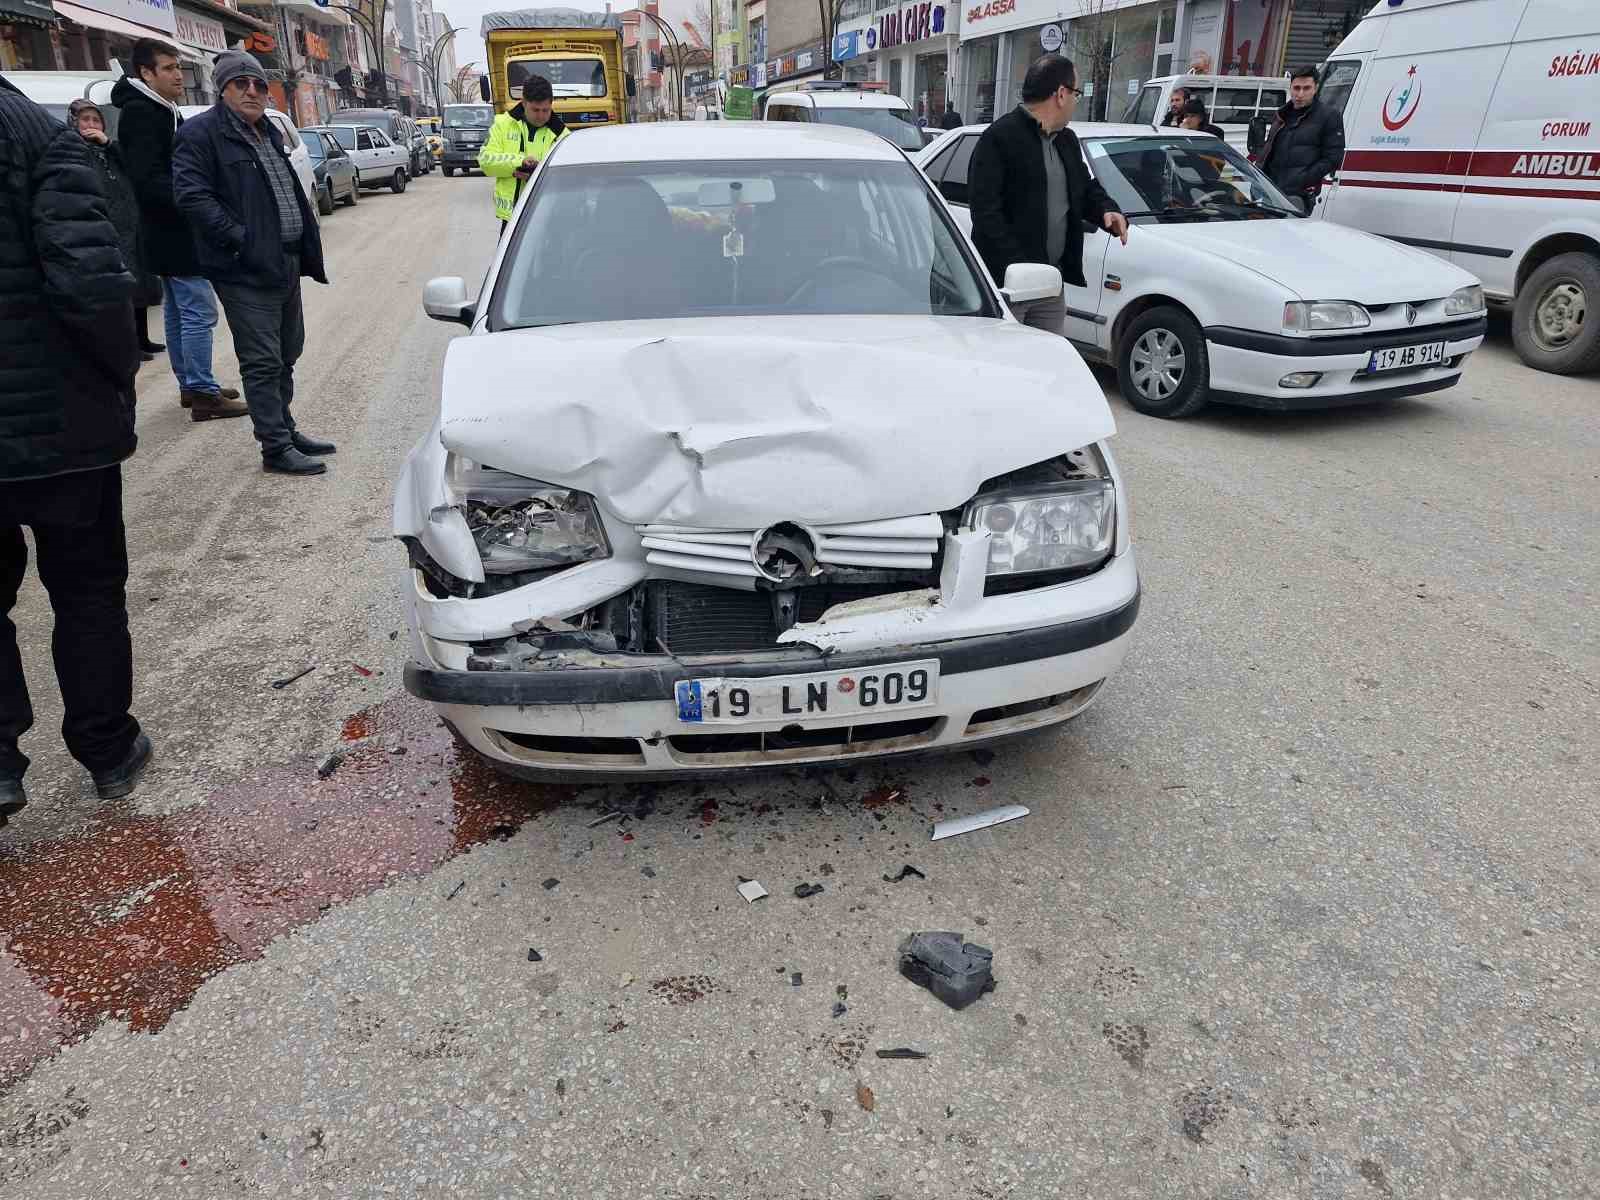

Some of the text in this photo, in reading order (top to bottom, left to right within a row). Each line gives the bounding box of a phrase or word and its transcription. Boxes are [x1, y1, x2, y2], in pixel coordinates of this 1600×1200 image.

[1541, 122, 1591, 141] ÇORUM
[1511, 155, 1600, 176] AMBUL
[1380, 351, 1396, 368] 19
[1400, 347, 1416, 365] AB
[1420, 343, 1441, 362] 914
[707, 687, 750, 717] 19
[782, 682, 828, 714] LN
[859, 669, 928, 707] 609
